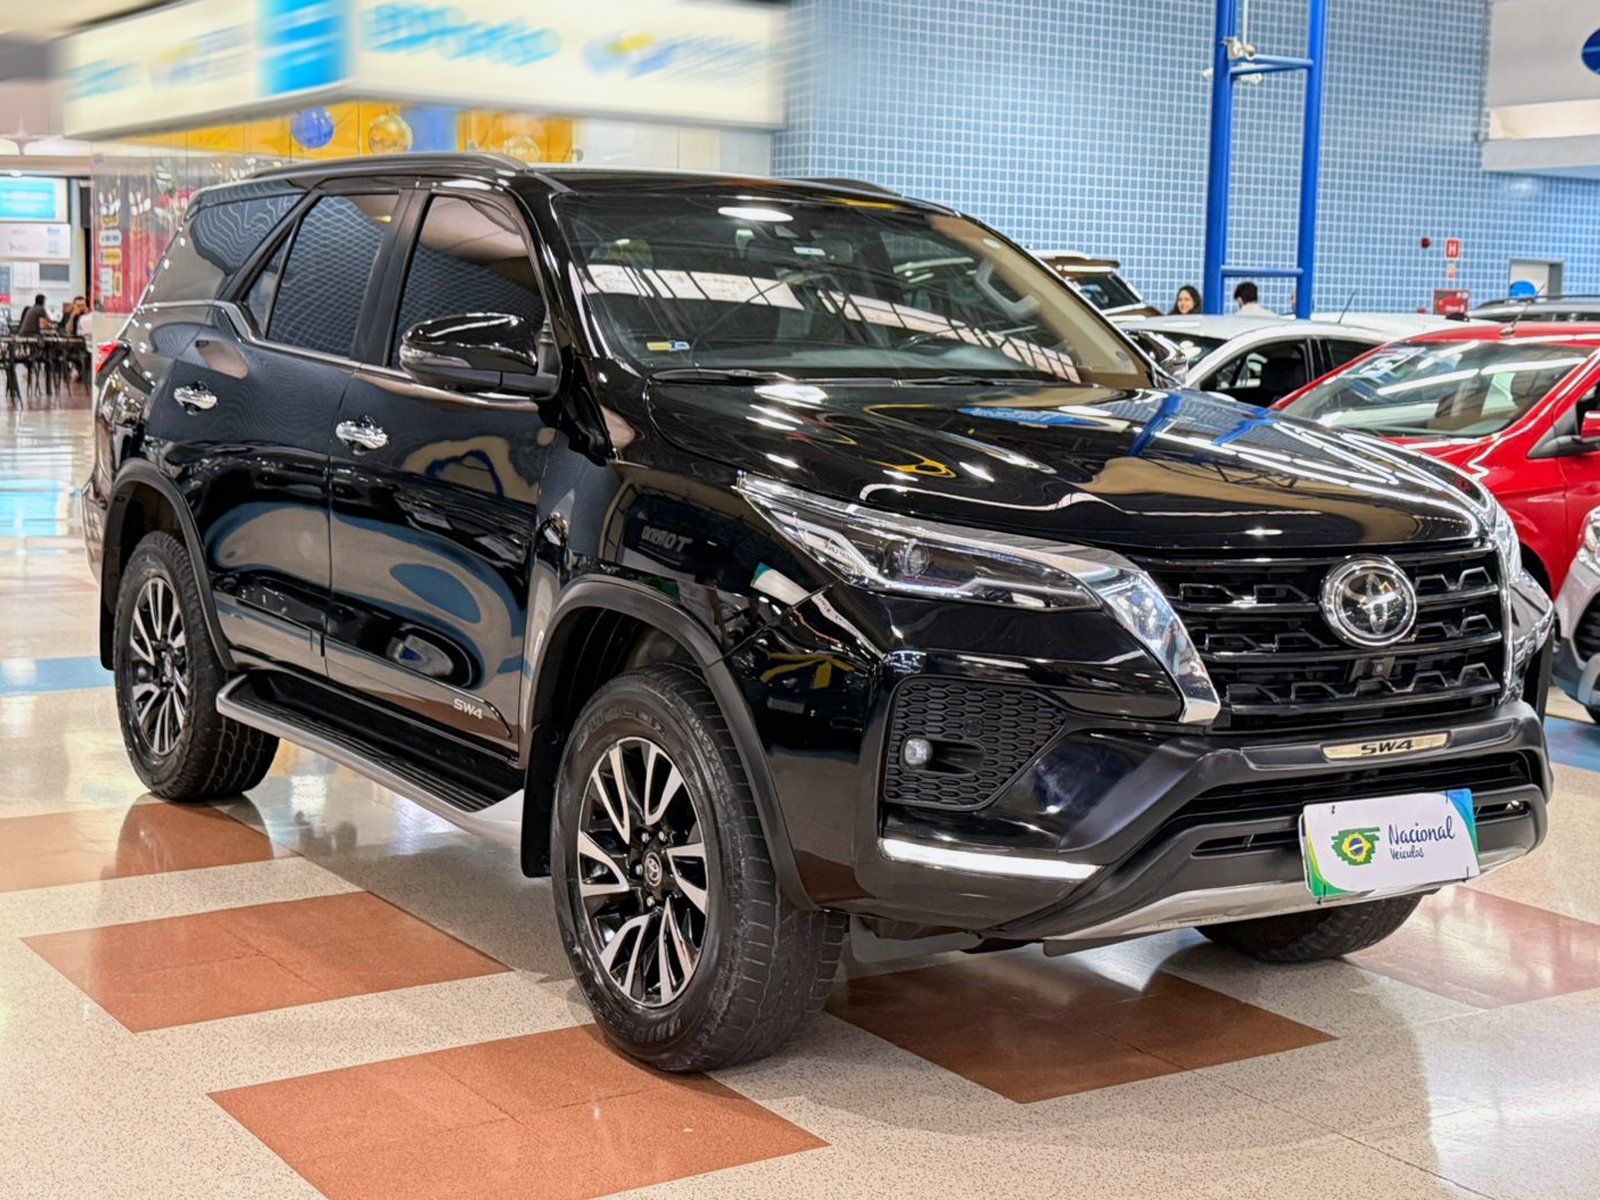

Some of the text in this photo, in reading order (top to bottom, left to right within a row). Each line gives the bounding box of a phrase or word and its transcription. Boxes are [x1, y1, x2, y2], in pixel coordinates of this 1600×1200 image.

[453, 698, 483, 719] SW4
[1361, 739, 1413, 755] SW4
[1388, 815, 1456, 846] Nacional
